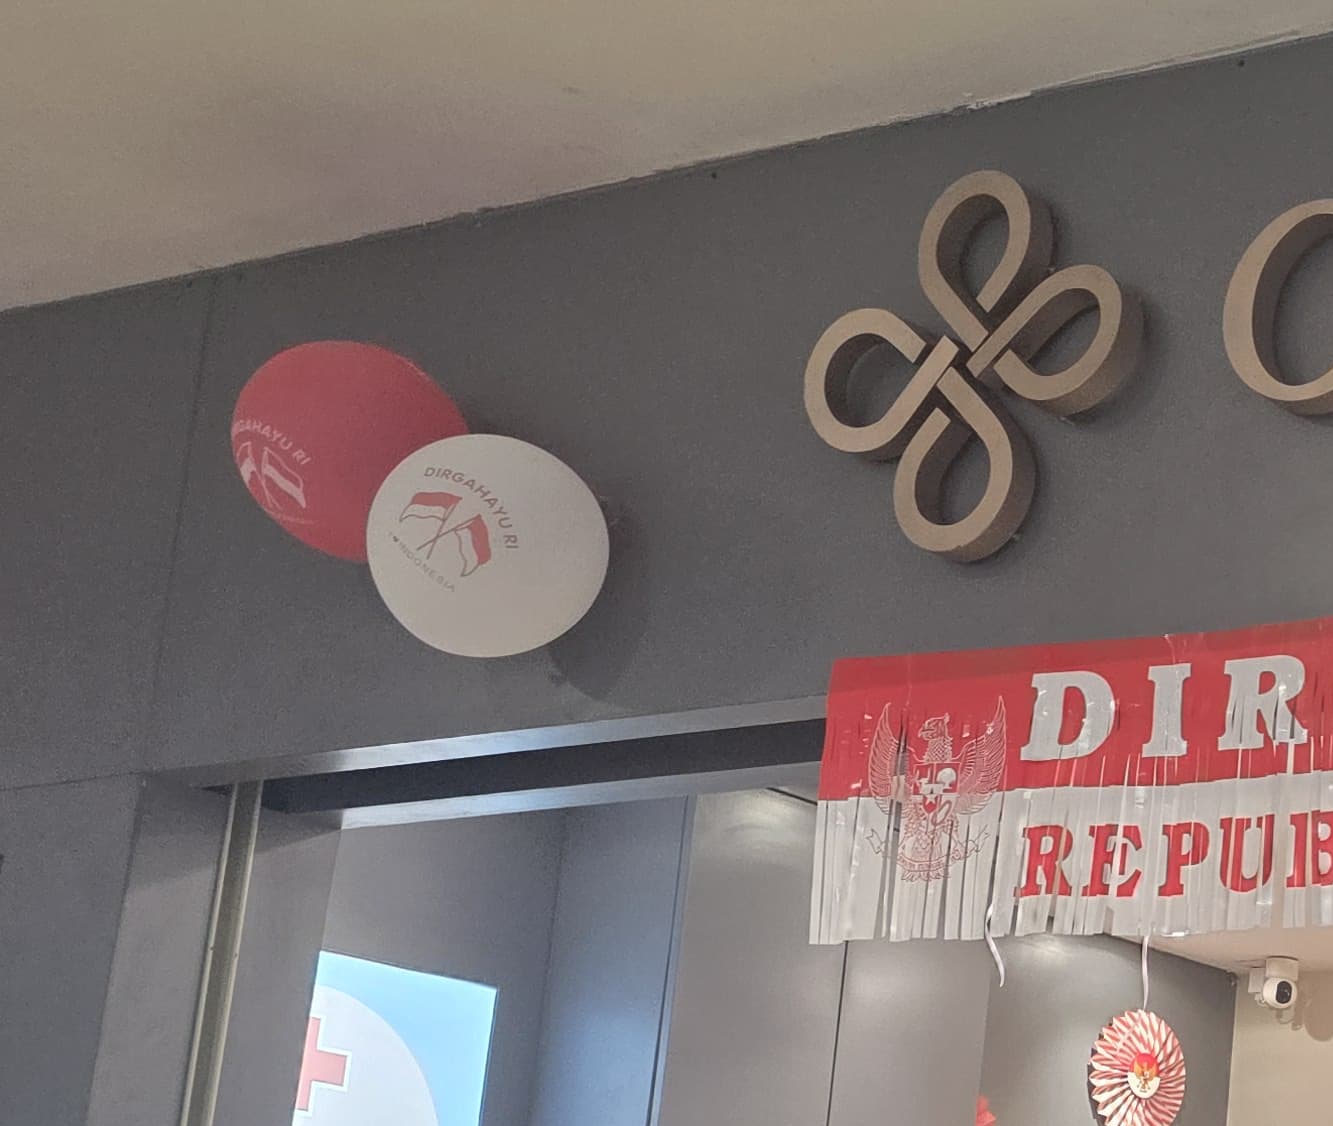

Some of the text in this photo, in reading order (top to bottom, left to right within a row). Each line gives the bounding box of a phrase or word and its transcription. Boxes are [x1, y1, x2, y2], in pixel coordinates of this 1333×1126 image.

[231, 419, 311, 464] GAHAYU RI
[424, 467, 519, 549] DIRGAHAYU RI
